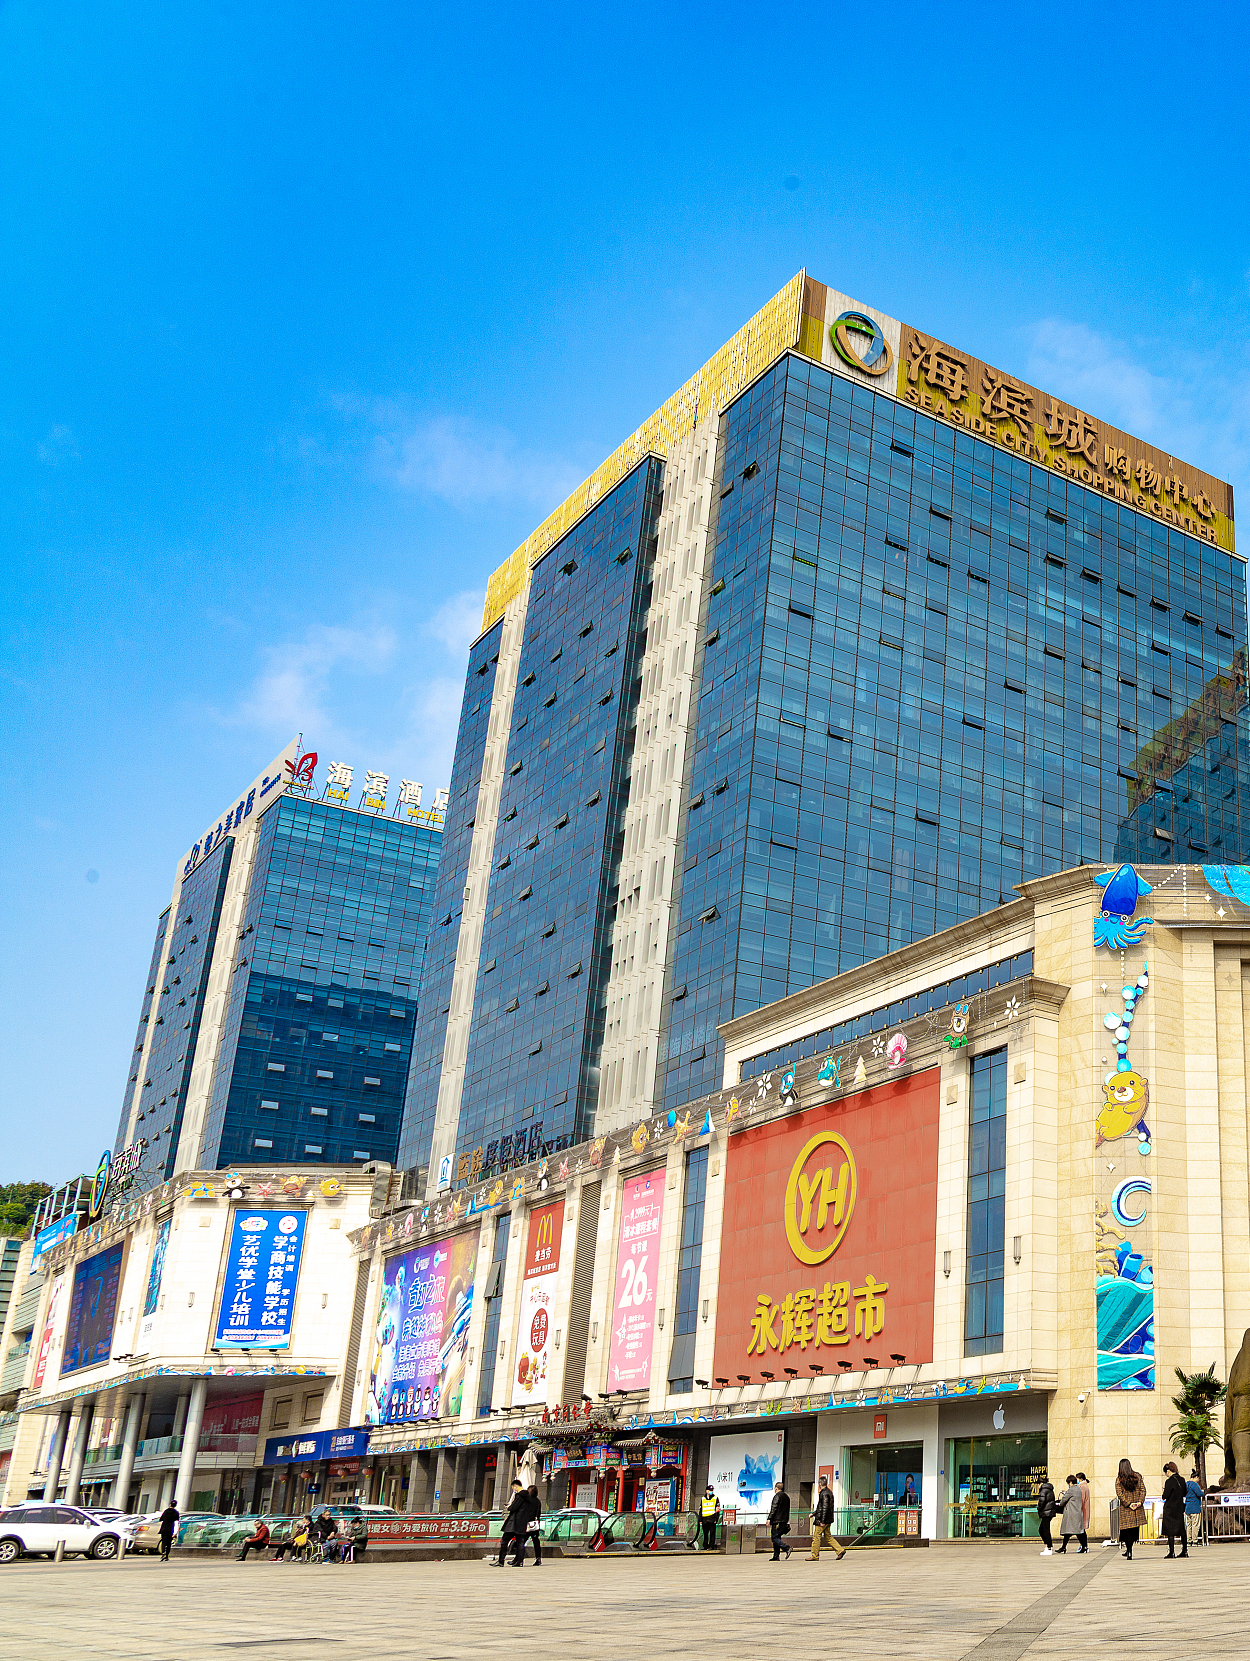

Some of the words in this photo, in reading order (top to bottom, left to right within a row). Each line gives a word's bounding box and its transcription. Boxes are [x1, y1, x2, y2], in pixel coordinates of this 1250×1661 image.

[907, 333, 1099, 466] 海滨城
[1104, 442, 1217, 519] 购物中心
[904, 386, 998, 442] SEASIDE
[1000, 430, 1049, 464] CITY
[1052, 456, 1148, 511] SHOPPING
[1149, 500, 1219, 543] CENTER
[327, 788, 350, 802] HAI
[365, 796, 387, 810] BIN
[407, 807, 445, 824] HOTEL
[798, 1161, 851, 1234] YH
[534, 1245, 552, 1263] 麦当劳
[229, 1234, 262, 1327] 艺优学堂少儿培训
[261, 1234, 289, 1327] 学商技能学校
[618, 1254, 649, 1309] 26
[645, 1288, 653, 1302] 元
[532, 1313, 547, 1330] 免费
[747, 1273, 889, 1355] 永辉超市
[531, 1330, 545, 1346] 玩具
[875, 1421, 885, 1432] MI
[1025, 1475, 1039, 1484] NEW
[402, 1522, 439, 1534] 为爱放价
